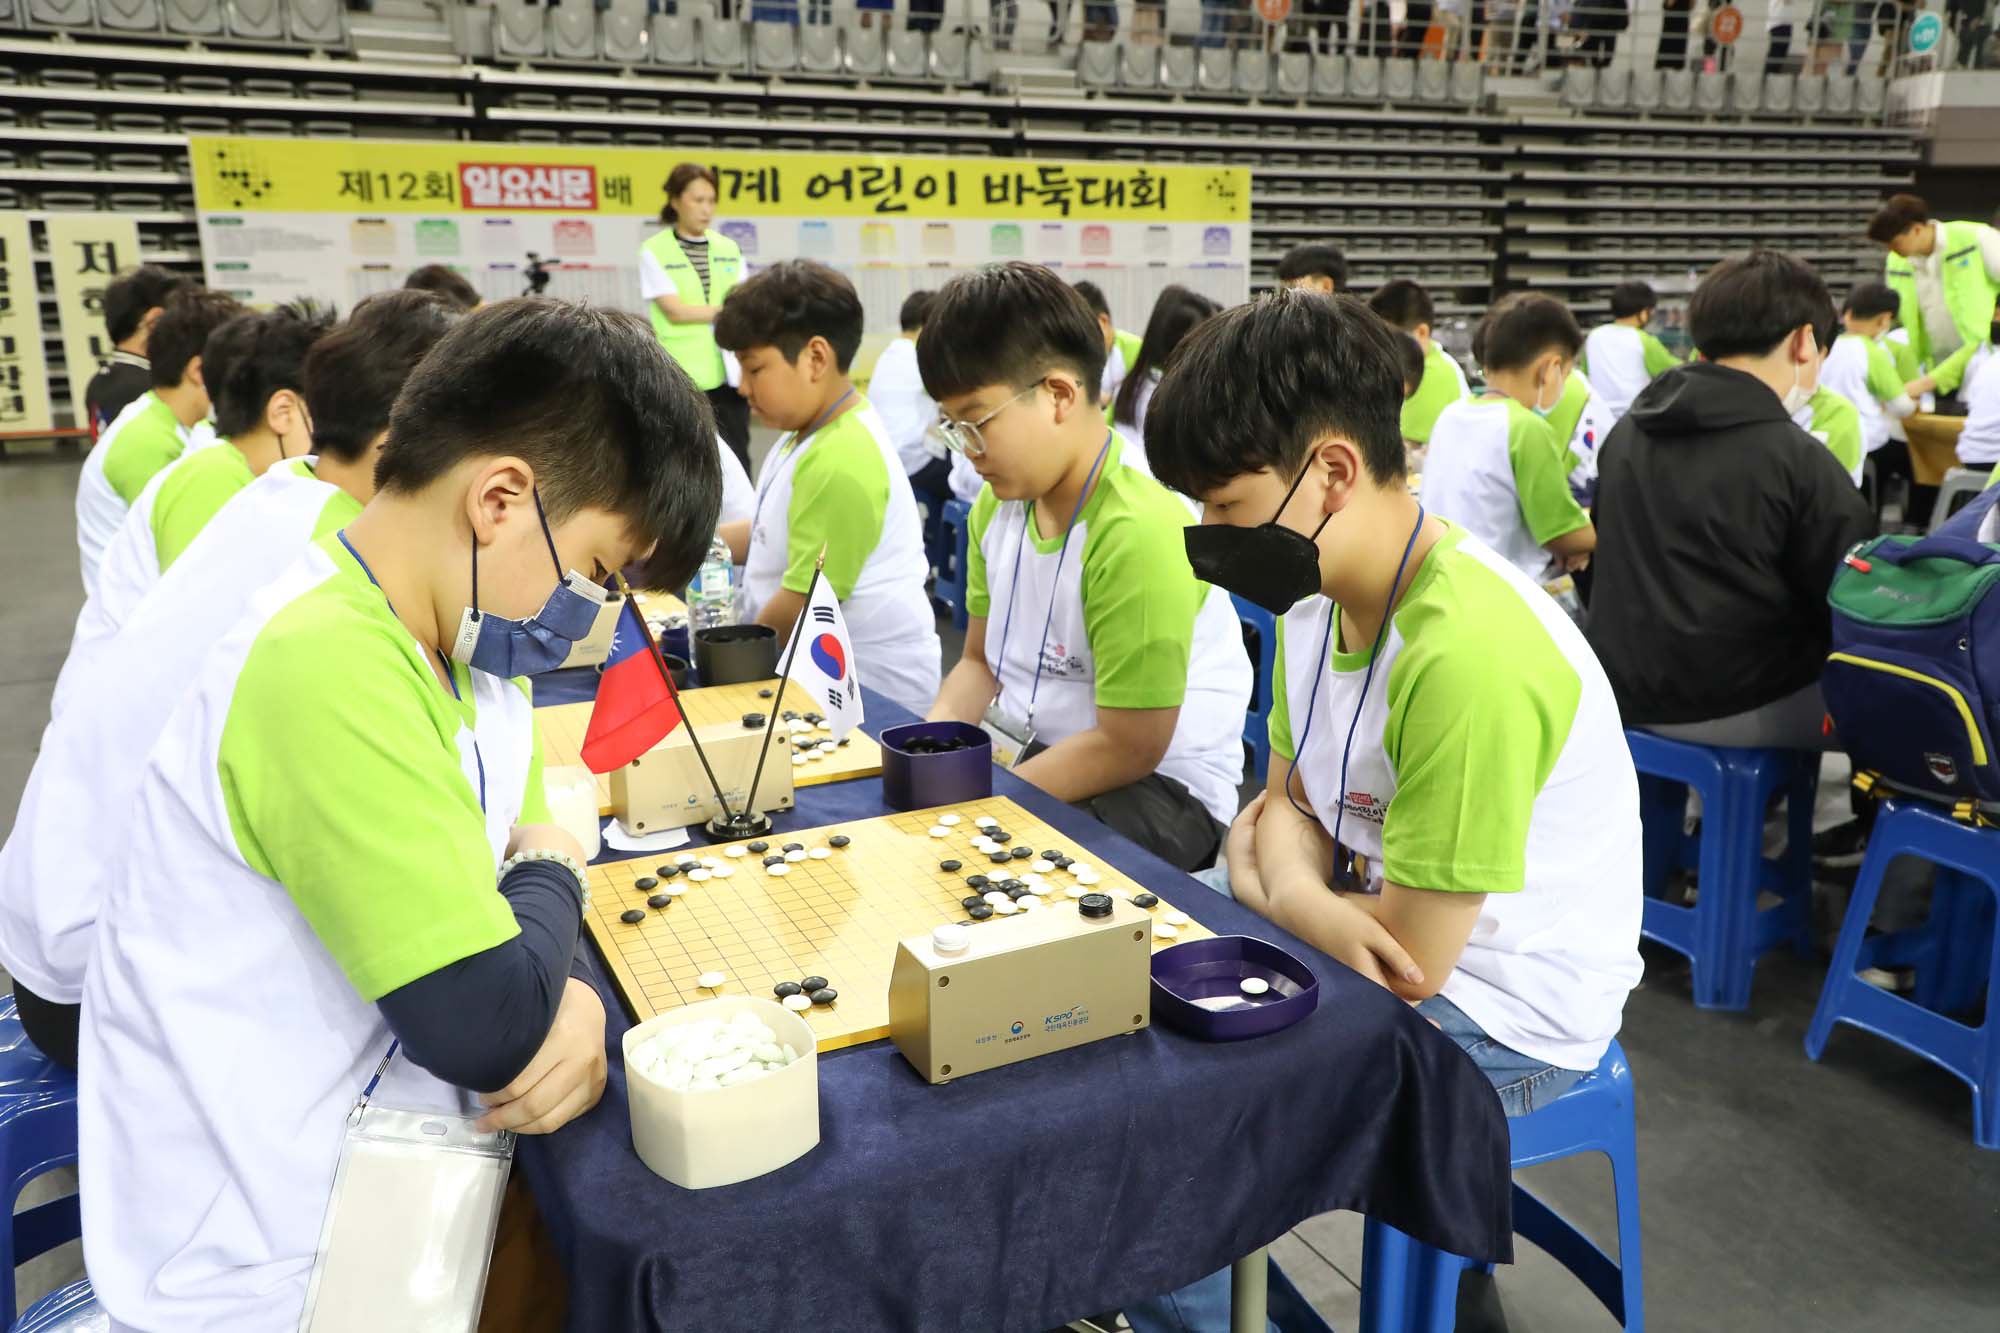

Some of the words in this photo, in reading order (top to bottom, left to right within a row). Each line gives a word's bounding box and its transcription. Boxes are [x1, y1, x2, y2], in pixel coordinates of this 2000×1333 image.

[338, 170, 454, 203] 제12회
[463, 166, 592, 208] 일요신문
[603, 176, 632, 205] 배
[711, 166, 780, 203] 계
[806, 165, 957, 212] 어린이
[983, 165, 1167, 216] 바둑대회
[1045, 1011, 1073, 1025] KSPO
